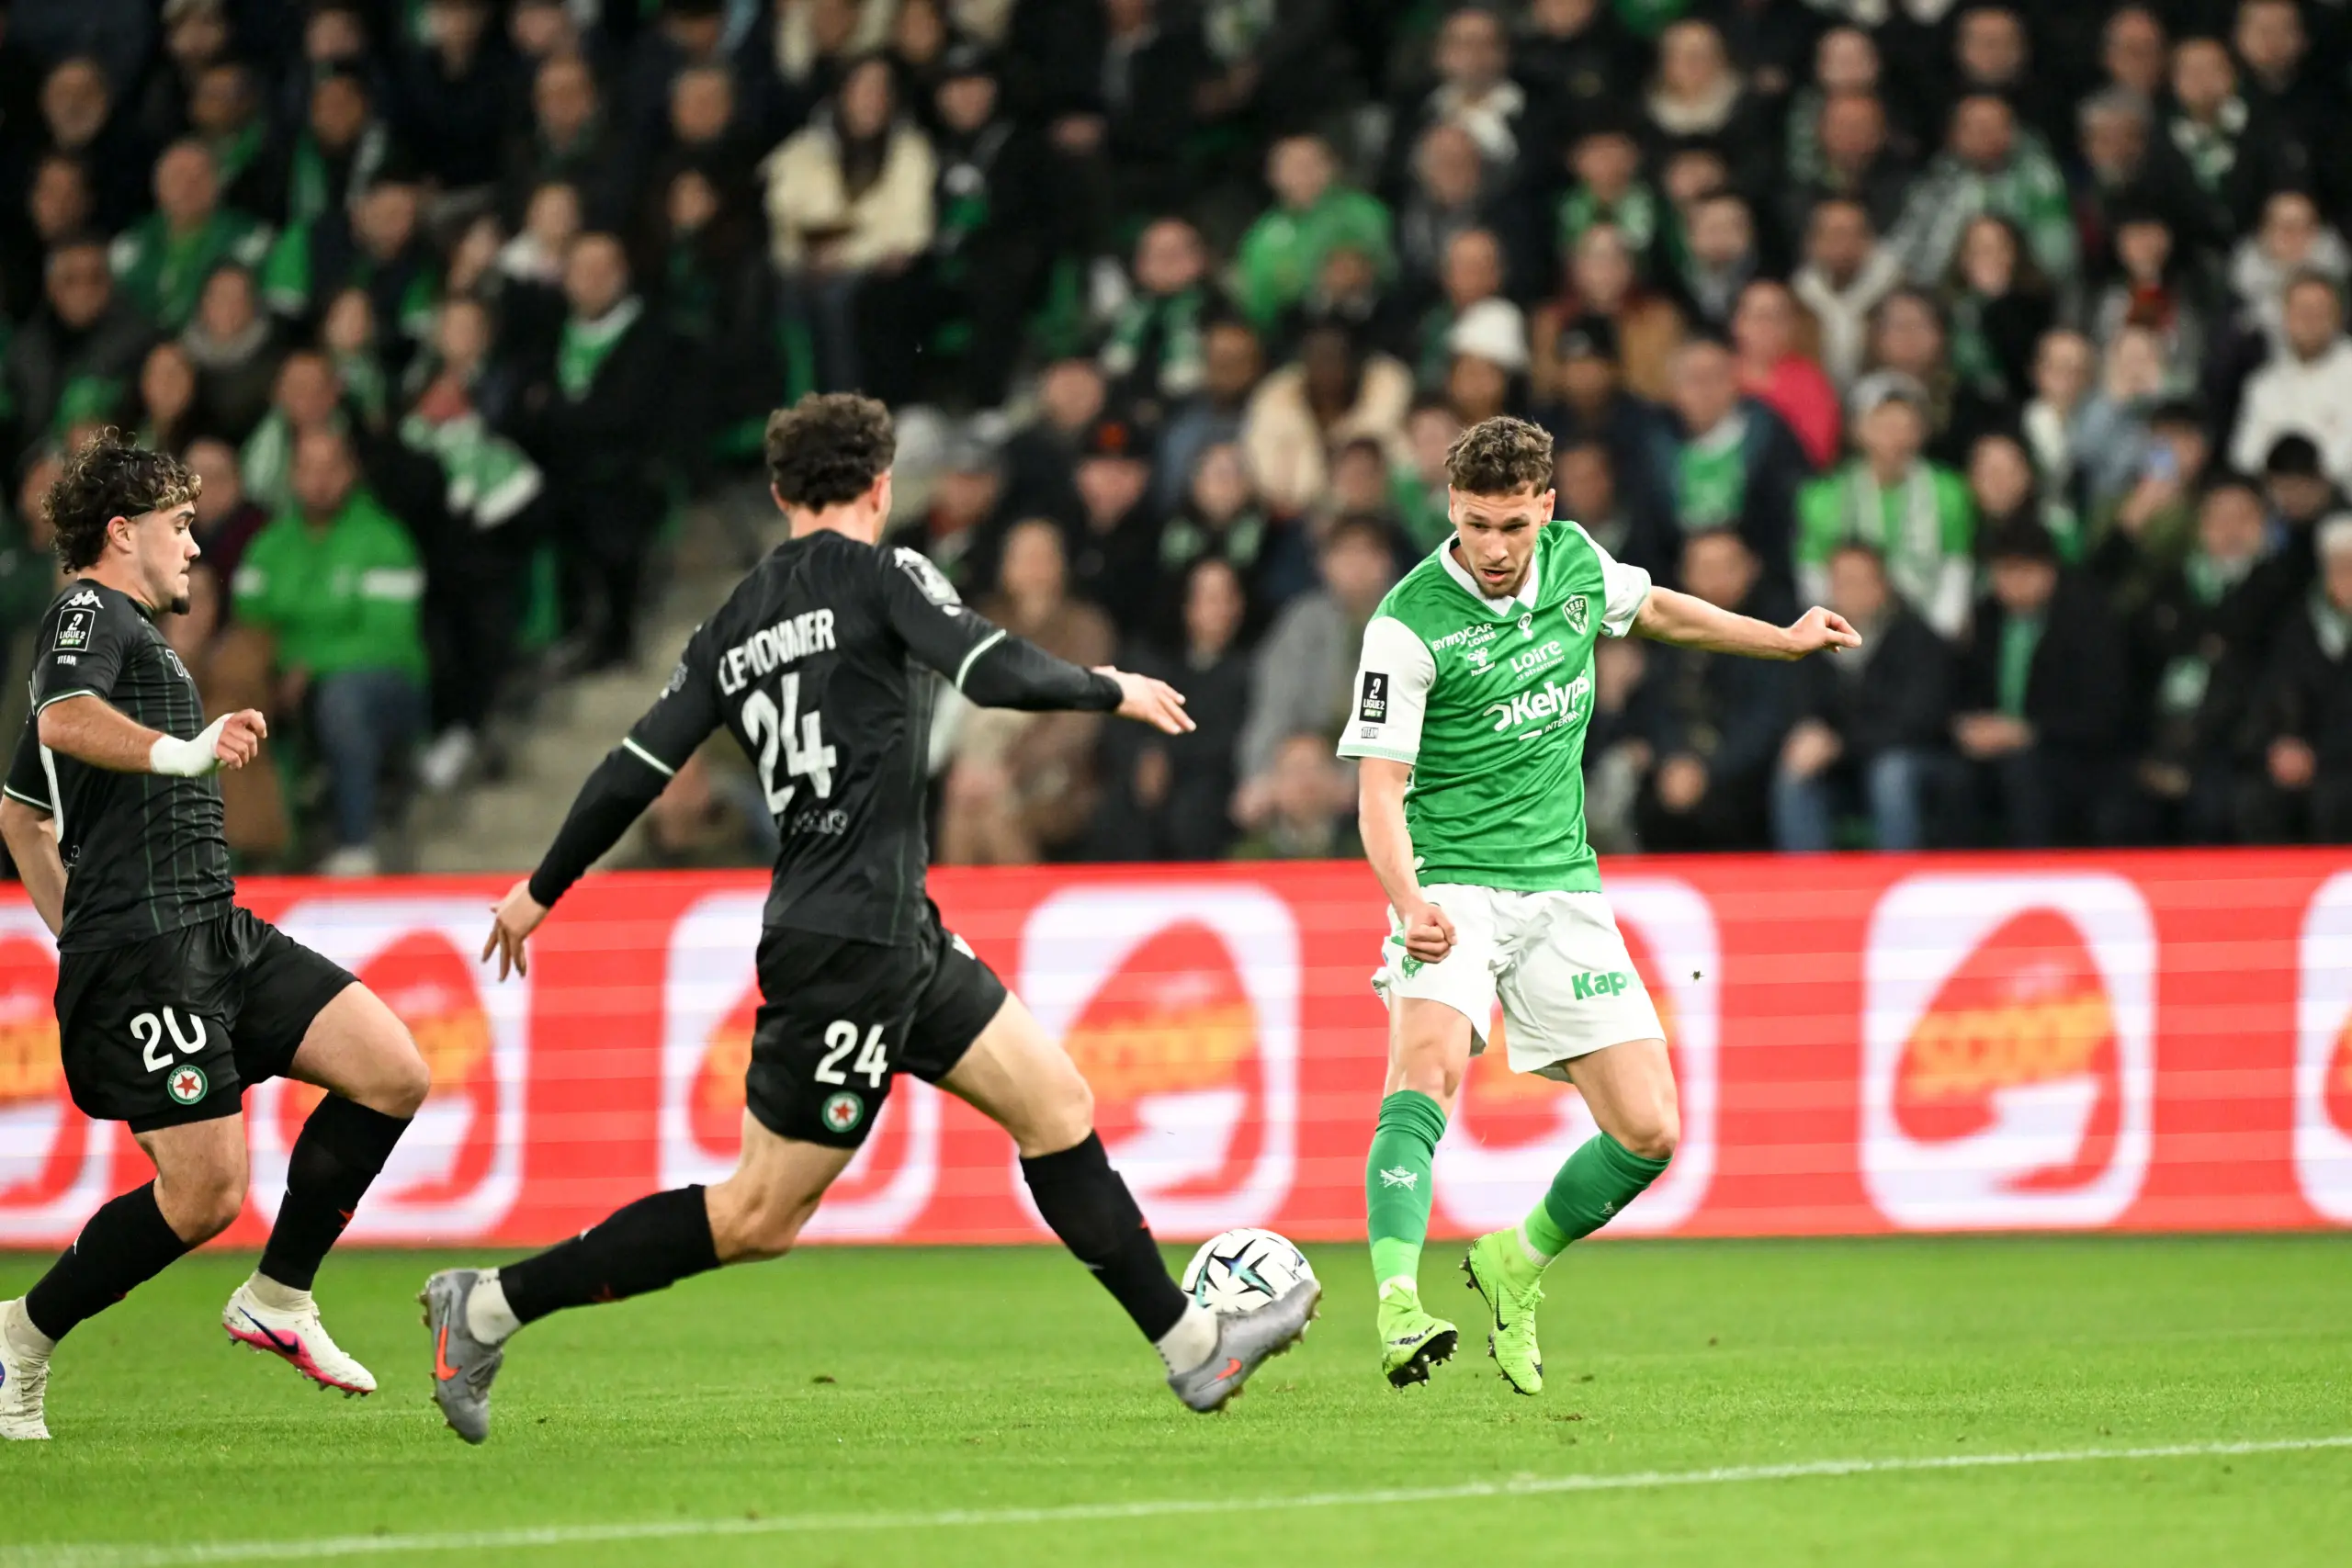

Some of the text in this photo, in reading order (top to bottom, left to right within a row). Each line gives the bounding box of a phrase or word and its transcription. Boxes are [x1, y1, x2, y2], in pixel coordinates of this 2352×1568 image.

[67, 613, 84, 631] 2
[1468, 631, 1498, 648] LOIRE
[1369, 677, 1382, 700] 2
[741, 671, 837, 815] 24
[1571, 971, 1638, 1000] Kap
[814, 1020, 890, 1089] 24
